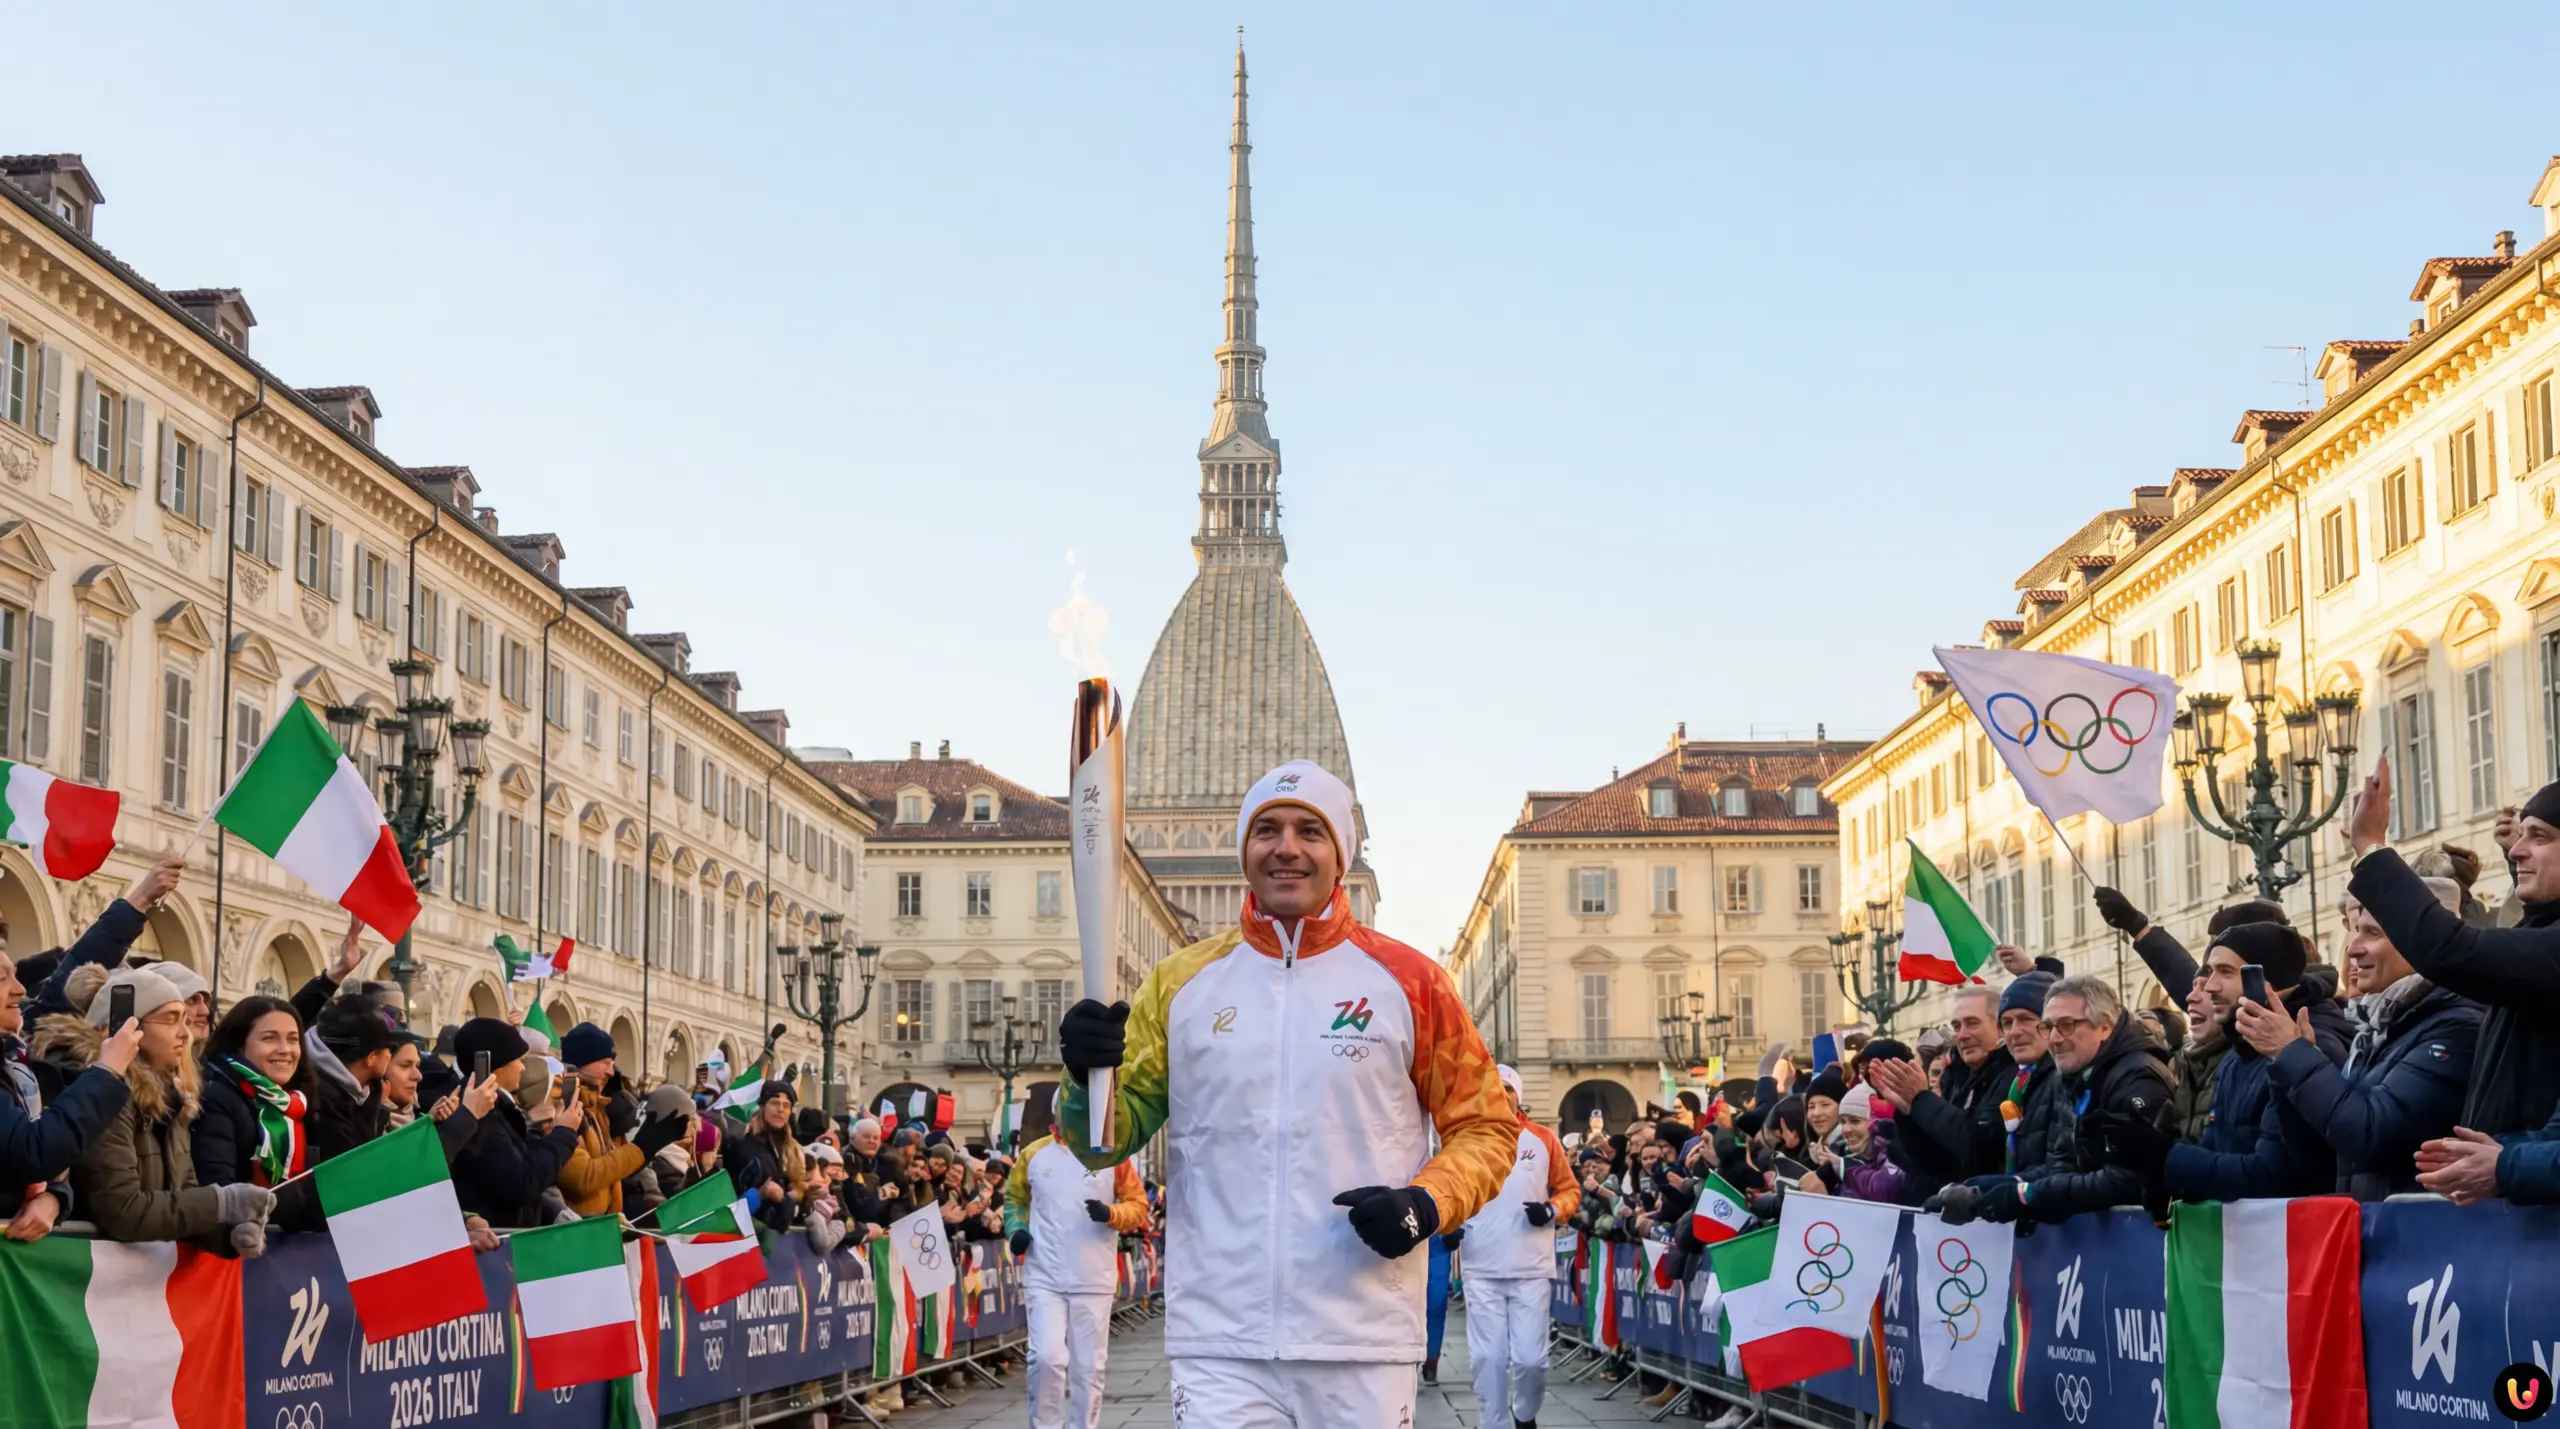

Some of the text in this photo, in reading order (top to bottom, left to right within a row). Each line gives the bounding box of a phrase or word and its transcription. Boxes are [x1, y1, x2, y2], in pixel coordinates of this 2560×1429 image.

[361, 1311, 505, 1374] MILANO CORTINA
[2115, 1308, 2166, 1364] MILA
[266, 1371, 334, 1395] MILANO CORTINA
[390, 1368, 482, 1429] 2026 ITALY
[2396, 1389, 2490, 1422] MILANO CORTINA
